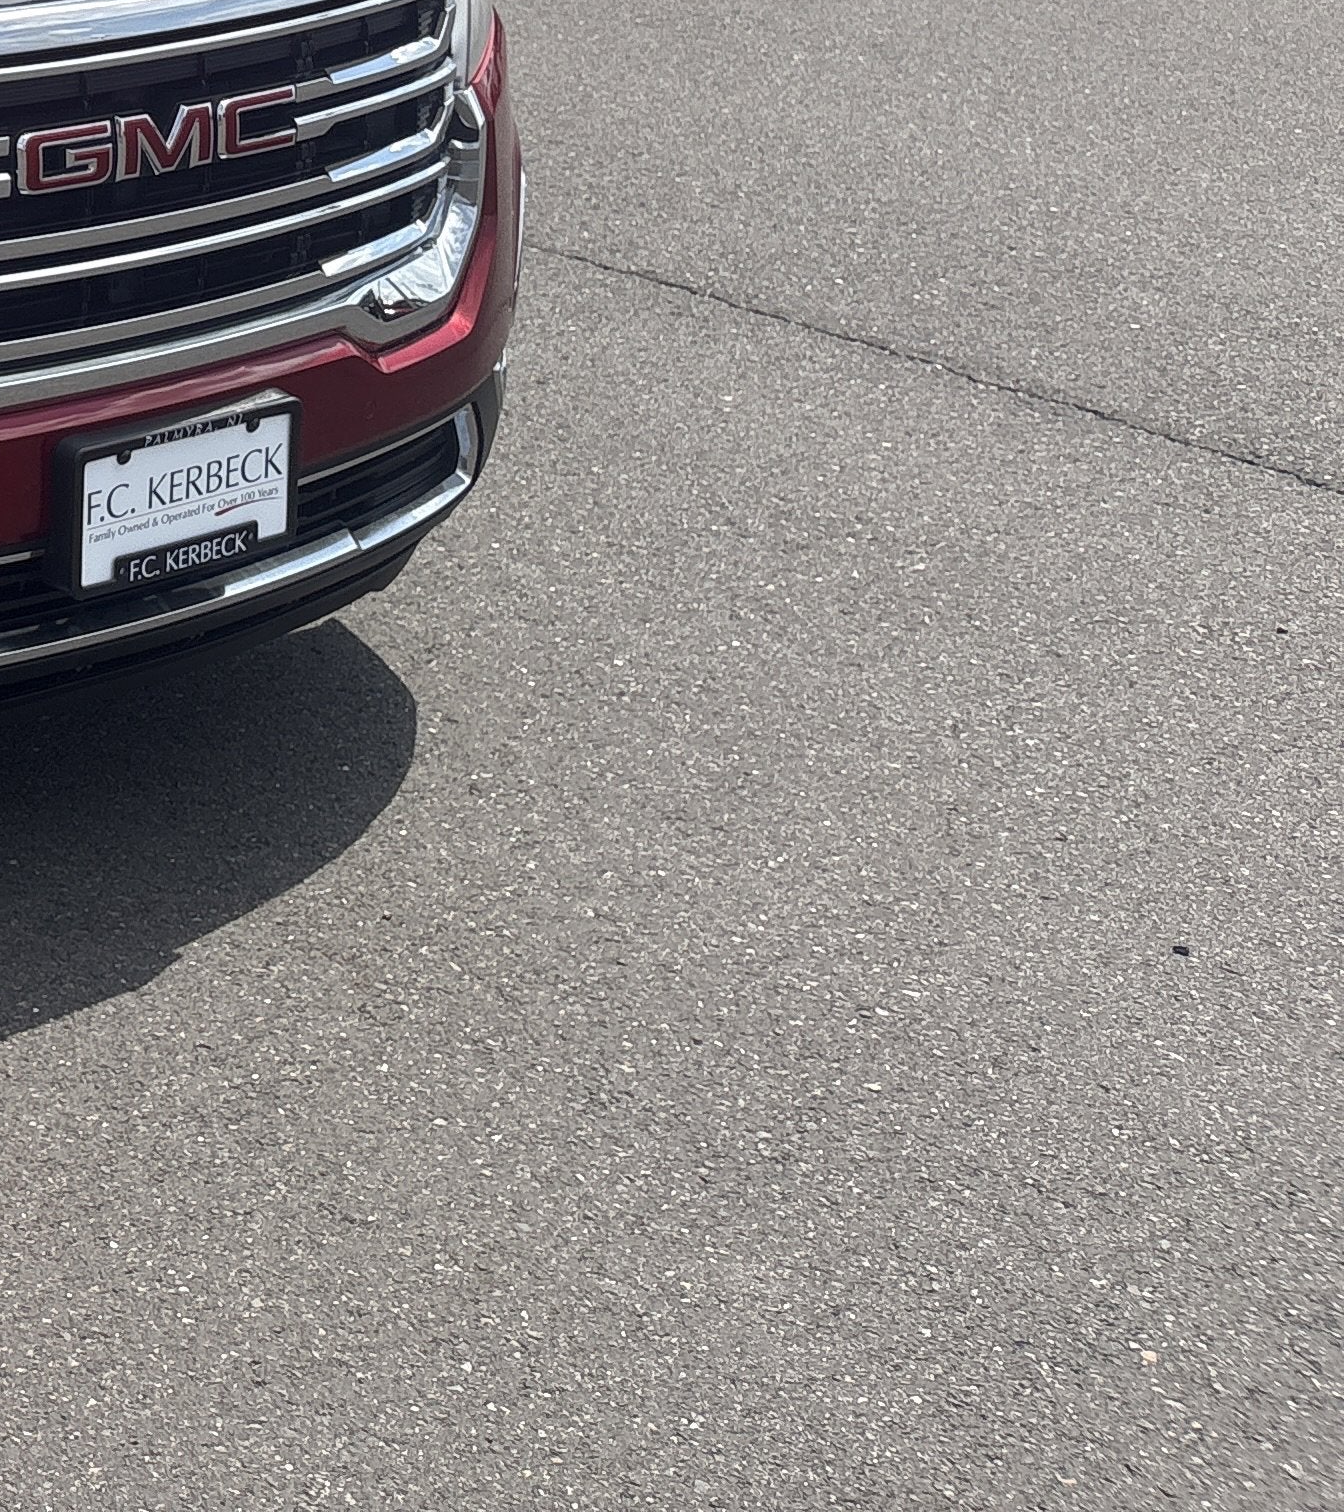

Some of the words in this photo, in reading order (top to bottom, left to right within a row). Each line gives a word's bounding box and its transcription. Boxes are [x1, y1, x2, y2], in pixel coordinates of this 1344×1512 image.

[16, 84, 298, 196] GMC
[87, 483, 136, 526] F.C.
[148, 443, 283, 510] KERBECK
[88, 528, 116, 544] Family
[118, 518, 150, 536] Owned
[152, 516, 159, 528] &
[161, 504, 200, 525] Operated
[201, 502, 216, 514] For
[217, 497, 238, 509] Over
[240, 490, 256, 501] 100
[257, 487, 279, 498] Years
[129, 555, 160, 582] F.C.
[165, 530, 248, 573] KERBECK
